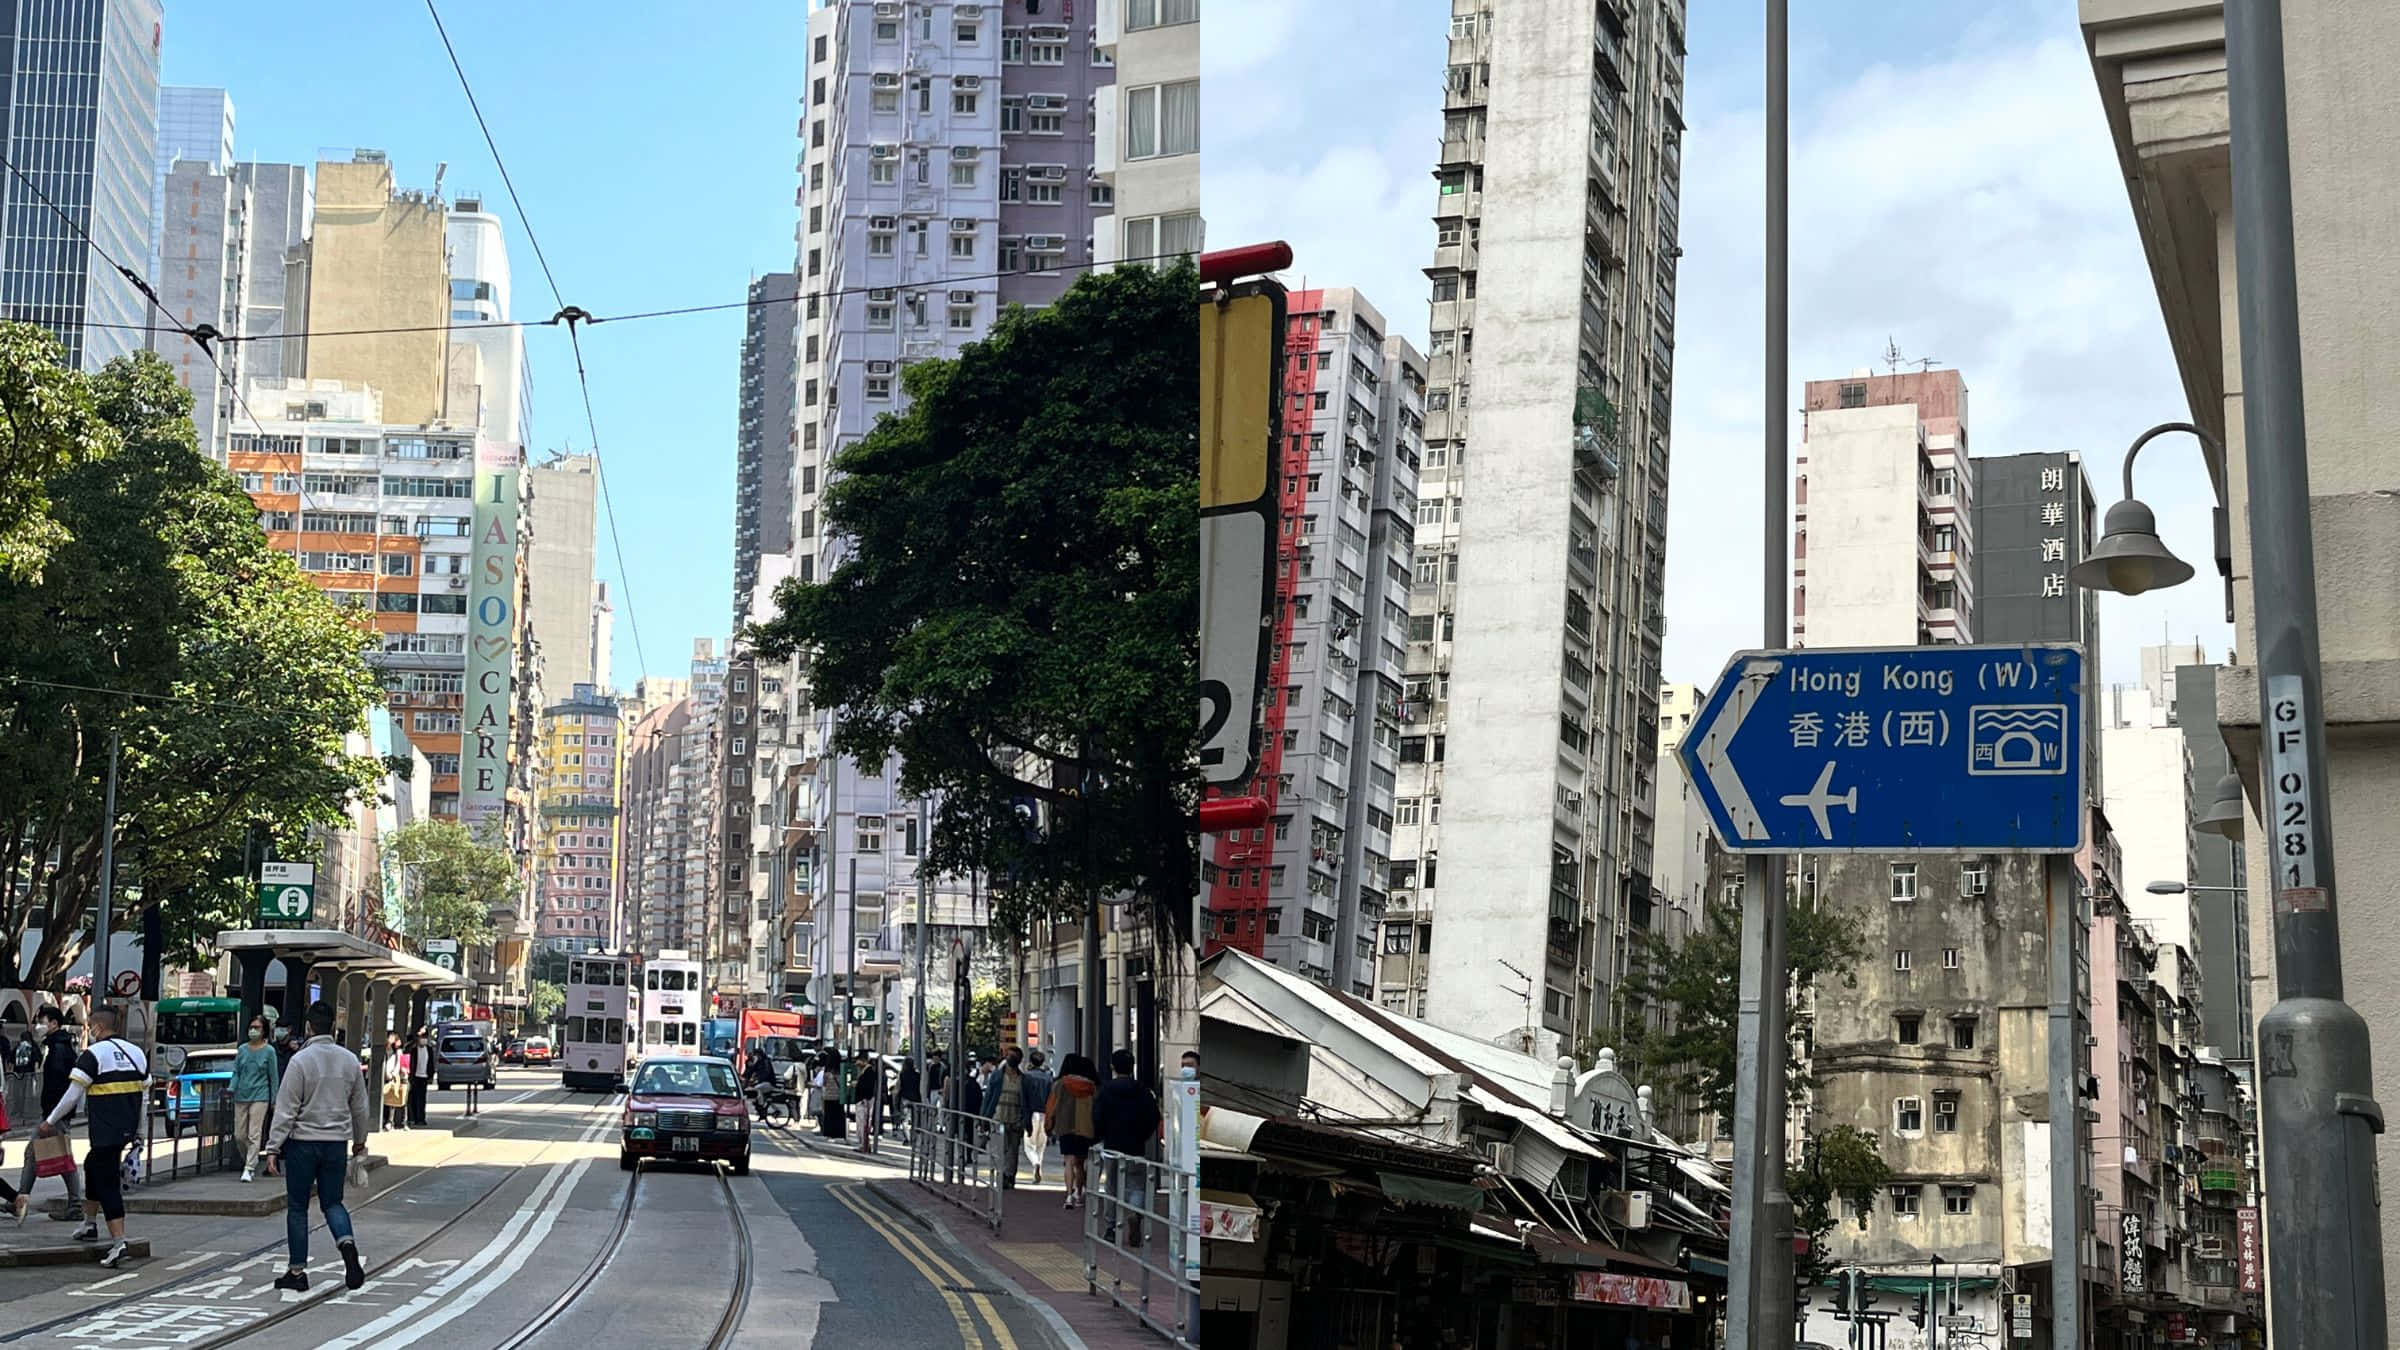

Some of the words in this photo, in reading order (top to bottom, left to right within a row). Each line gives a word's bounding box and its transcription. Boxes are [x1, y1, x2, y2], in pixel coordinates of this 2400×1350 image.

[479, 474, 508, 627] IASO
[2041, 467, 2065, 598] 朗華酒店
[1790, 667, 1861, 697] Hong
[1883, 664, 1953, 695] Kong
[1978, 661, 2038, 690] (W)
[475, 671, 500, 791] CARE
[1789, 710, 1950, 747] 香港(西)
[2275, 700, 2301, 754] GF
[1975, 743, 1993, 761] 西
[2043, 742, 2058, 762] W
